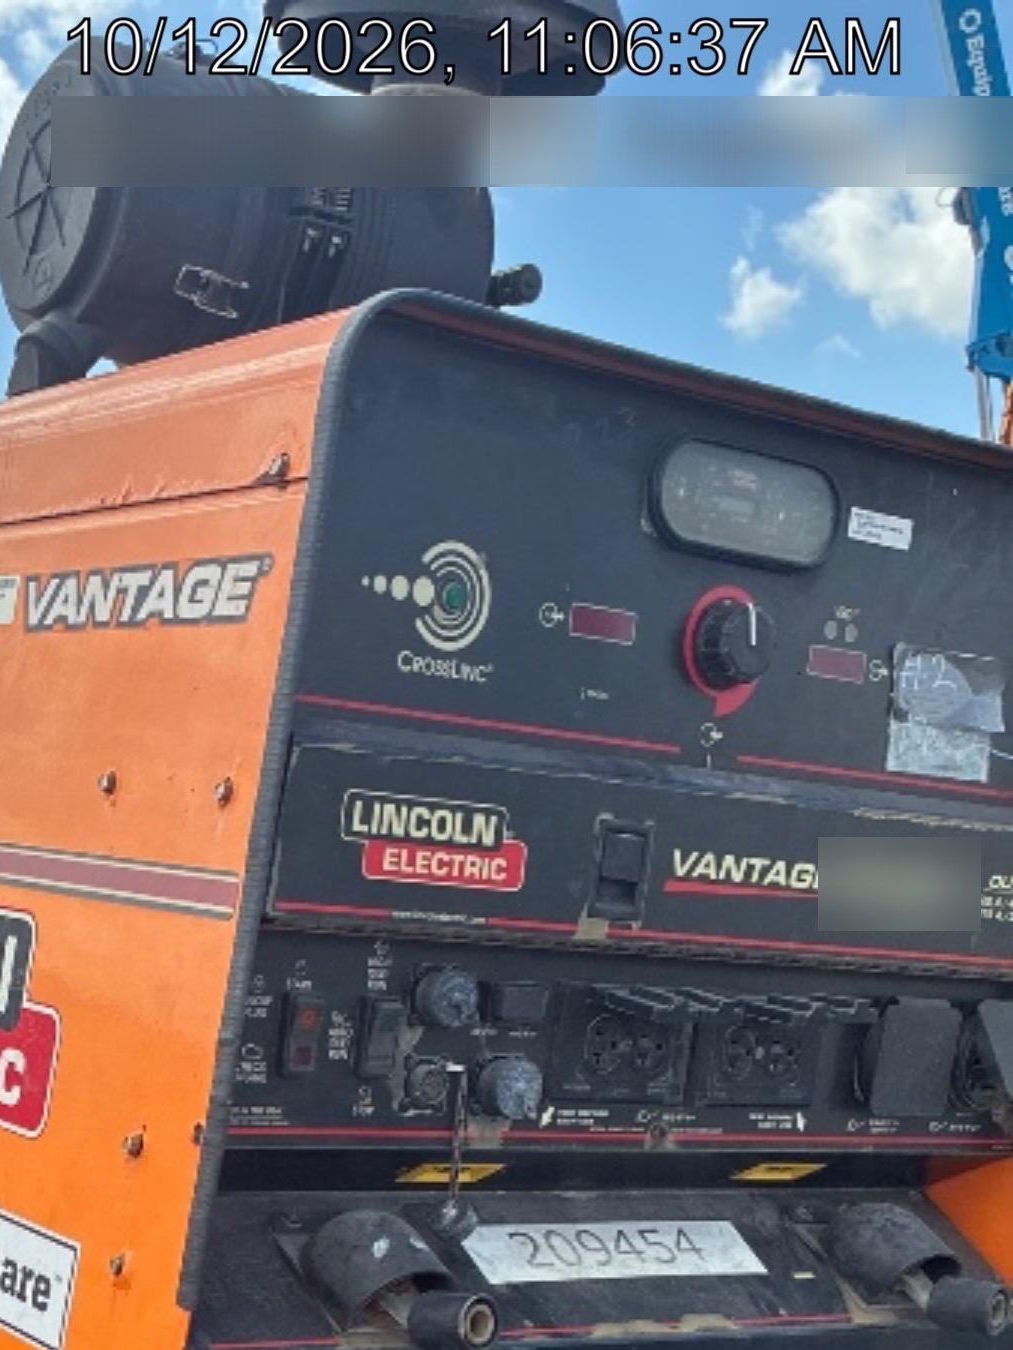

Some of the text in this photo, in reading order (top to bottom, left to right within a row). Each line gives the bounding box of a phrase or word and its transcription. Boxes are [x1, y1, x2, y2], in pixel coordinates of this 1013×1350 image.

[26, 560, 257, 629] VANTAGE
[351, 799, 498, 847] LINCOLN
[382, 846, 508, 881] ELECTRIC
[672, 847, 818, 890] VANTAG
[508, 1226, 706, 1268] 209454
